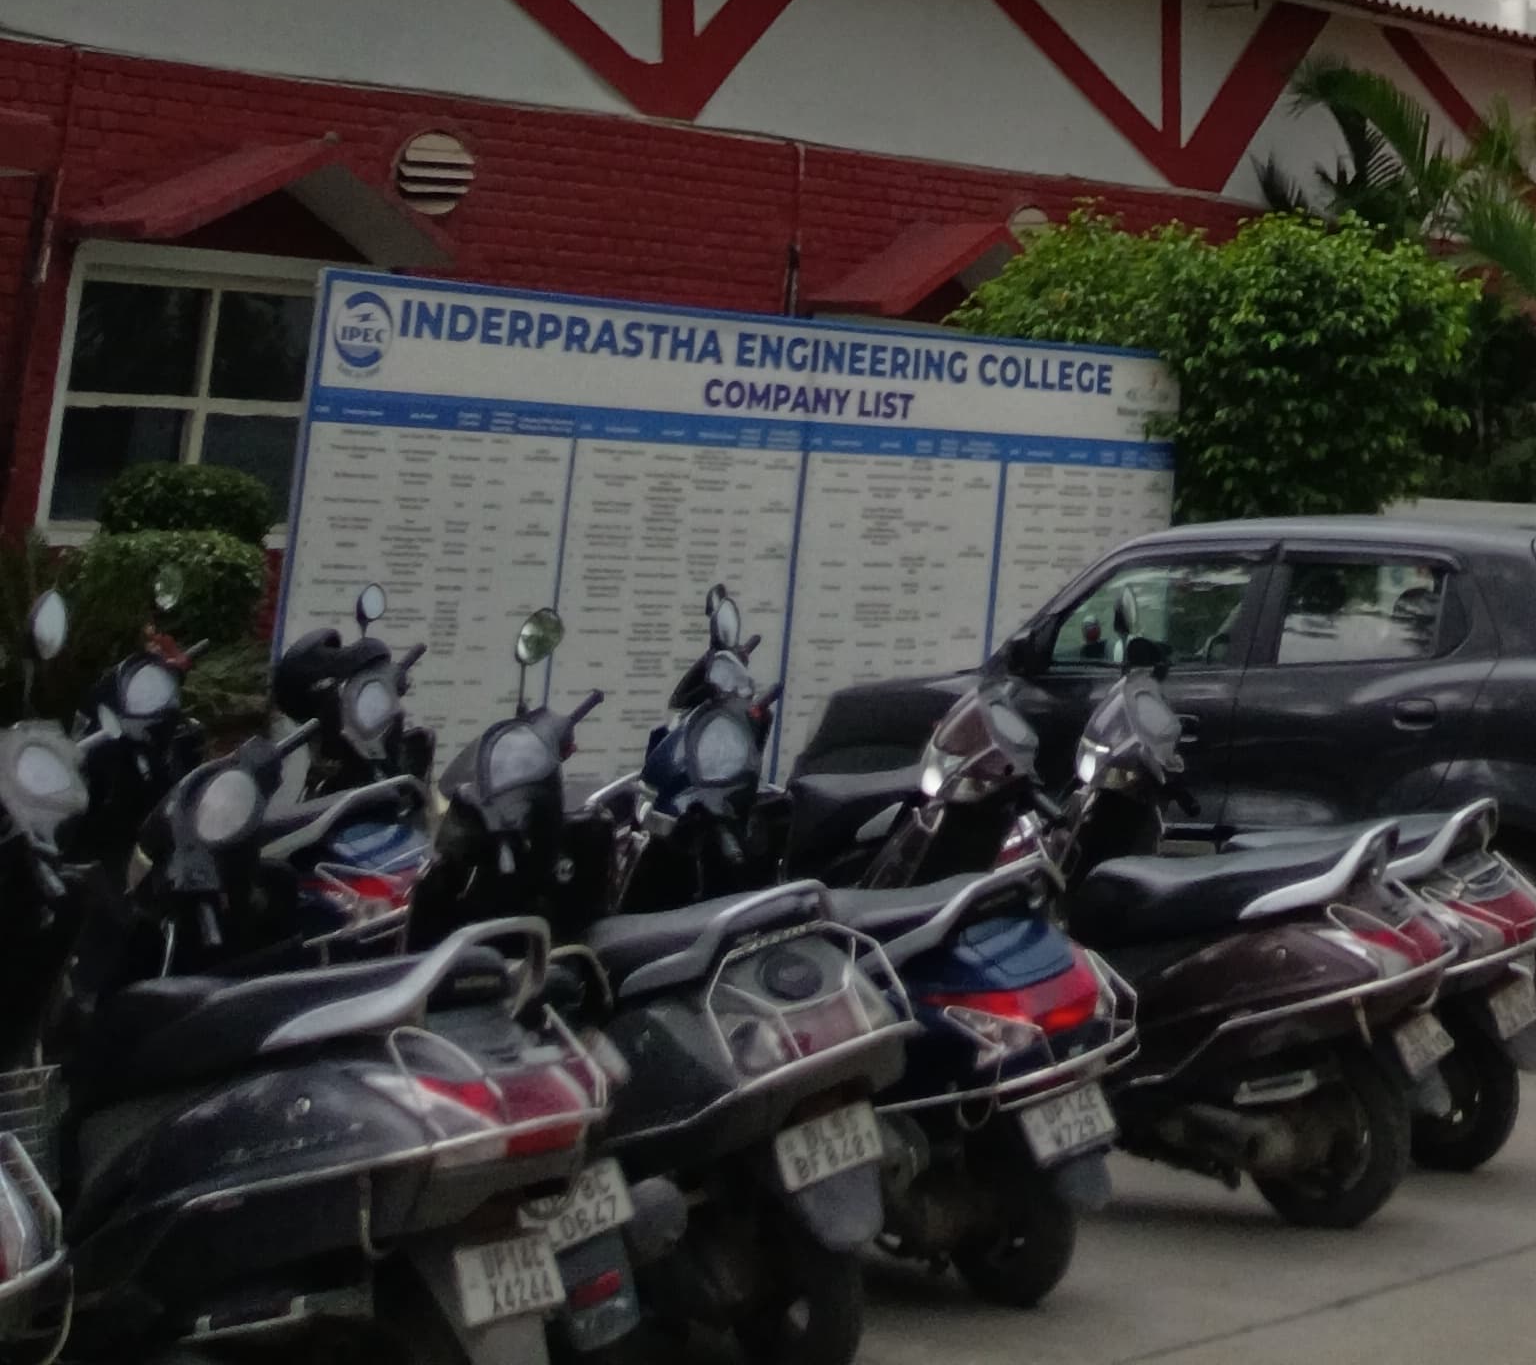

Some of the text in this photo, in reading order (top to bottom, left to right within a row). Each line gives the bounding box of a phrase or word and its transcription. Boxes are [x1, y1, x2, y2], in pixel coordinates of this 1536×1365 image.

[340, 325, 385, 344] IPEC
[399, 298, 1114, 396] INDERPRASTHA ENGINEERING COLLEGE
[703, 378, 916, 420] COMPANY LIST
